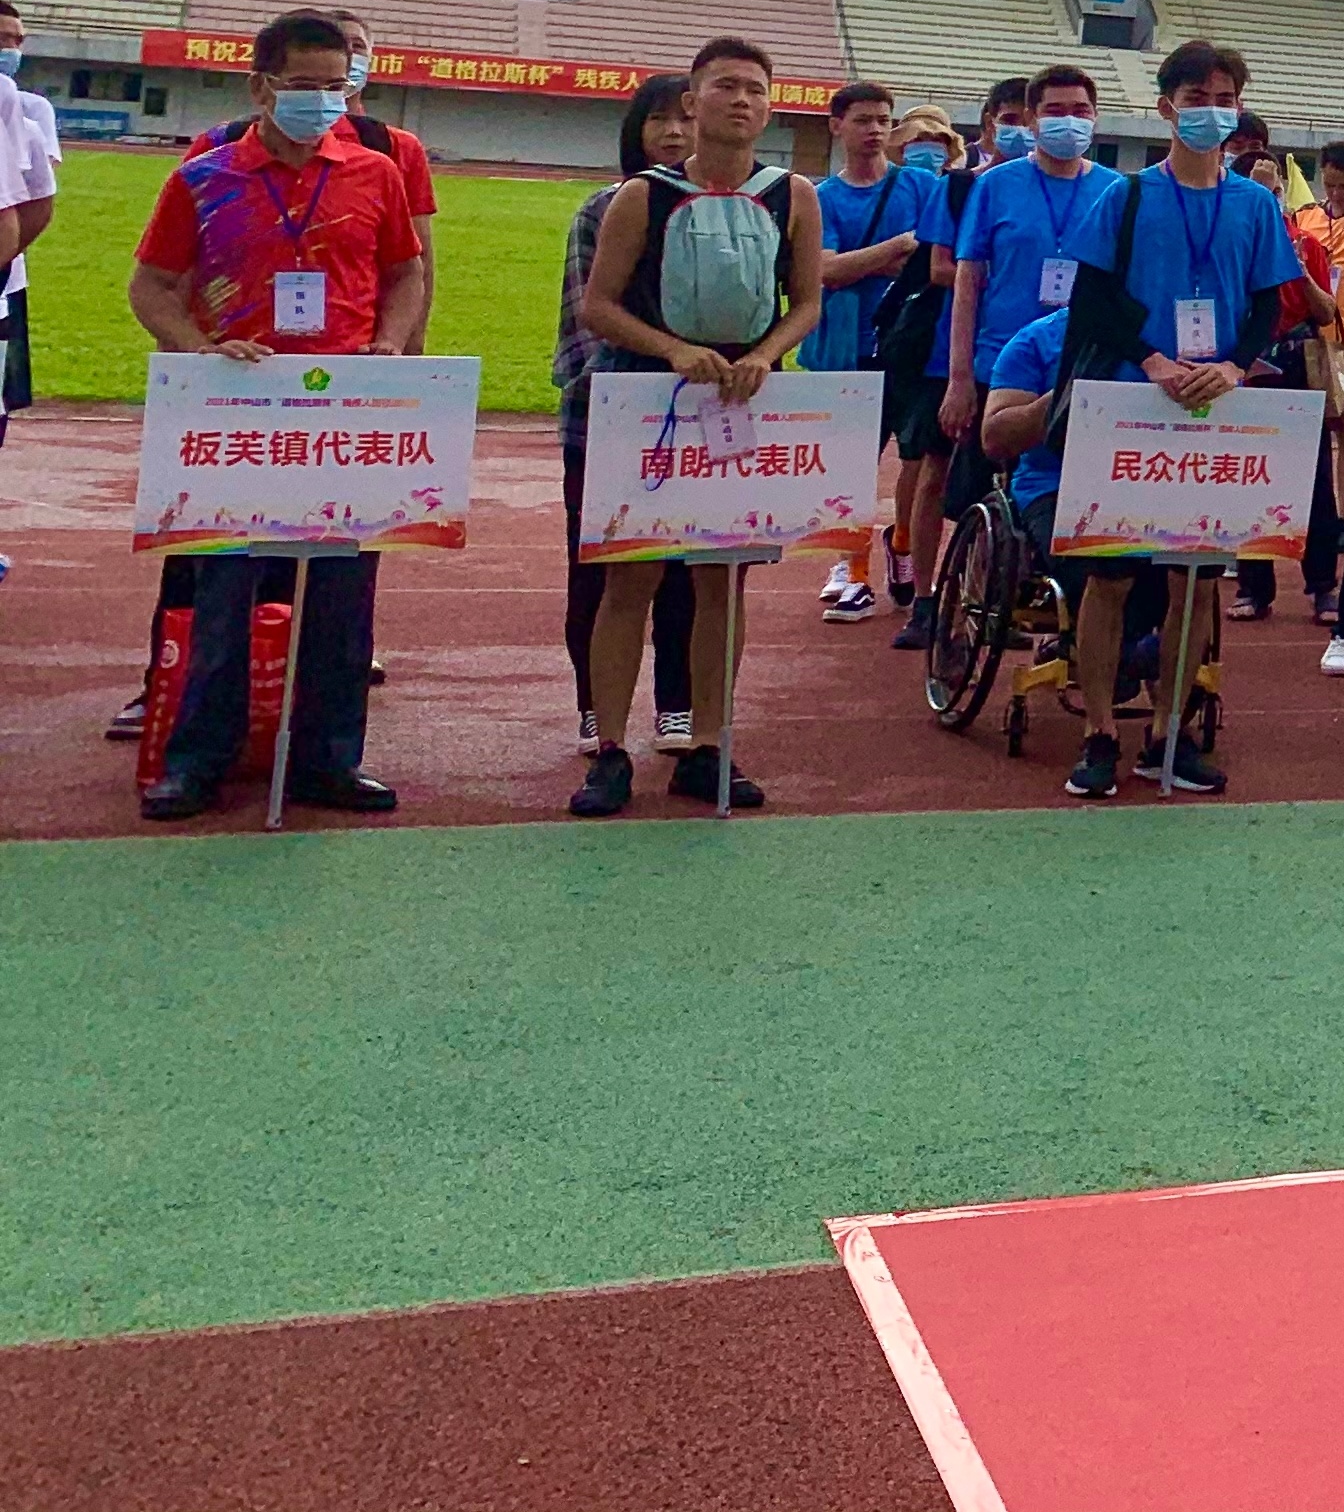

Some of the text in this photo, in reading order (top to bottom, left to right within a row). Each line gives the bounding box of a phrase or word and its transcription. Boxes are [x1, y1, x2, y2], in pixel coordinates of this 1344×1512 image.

[179, 429, 436, 468] 板芙镇代表队
[639, 442, 827, 481] 南朗代表队
[1110, 450, 1271, 487] 民众代表队
